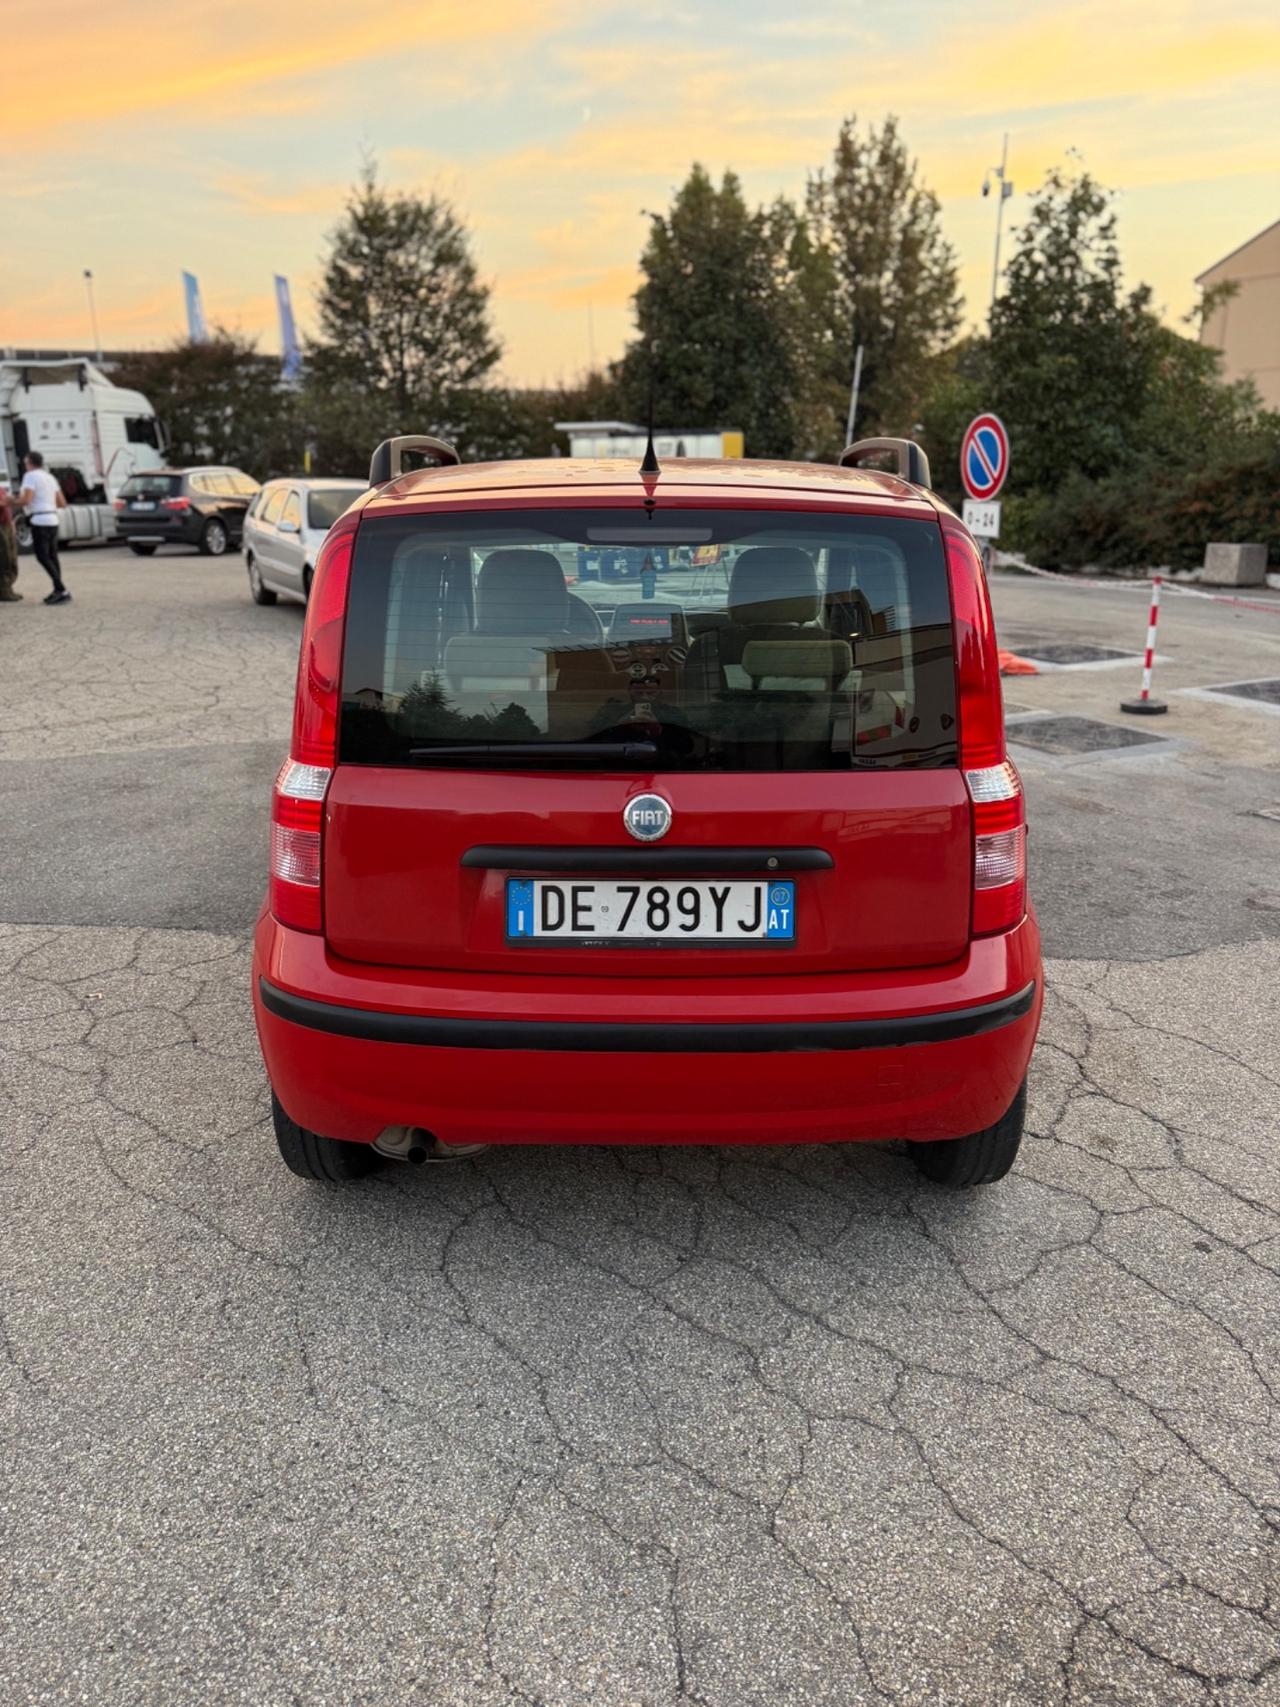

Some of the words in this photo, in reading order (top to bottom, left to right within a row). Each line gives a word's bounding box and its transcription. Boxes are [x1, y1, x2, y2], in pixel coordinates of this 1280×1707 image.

[983, 512, 994, 527] 24
[632, 810, 663, 826] FIAT
[541, 885, 595, 932] DE
[616, 885, 762, 933] 789YJ
[769, 909, 790, 930] AT
[518, 910, 524, 931] I
